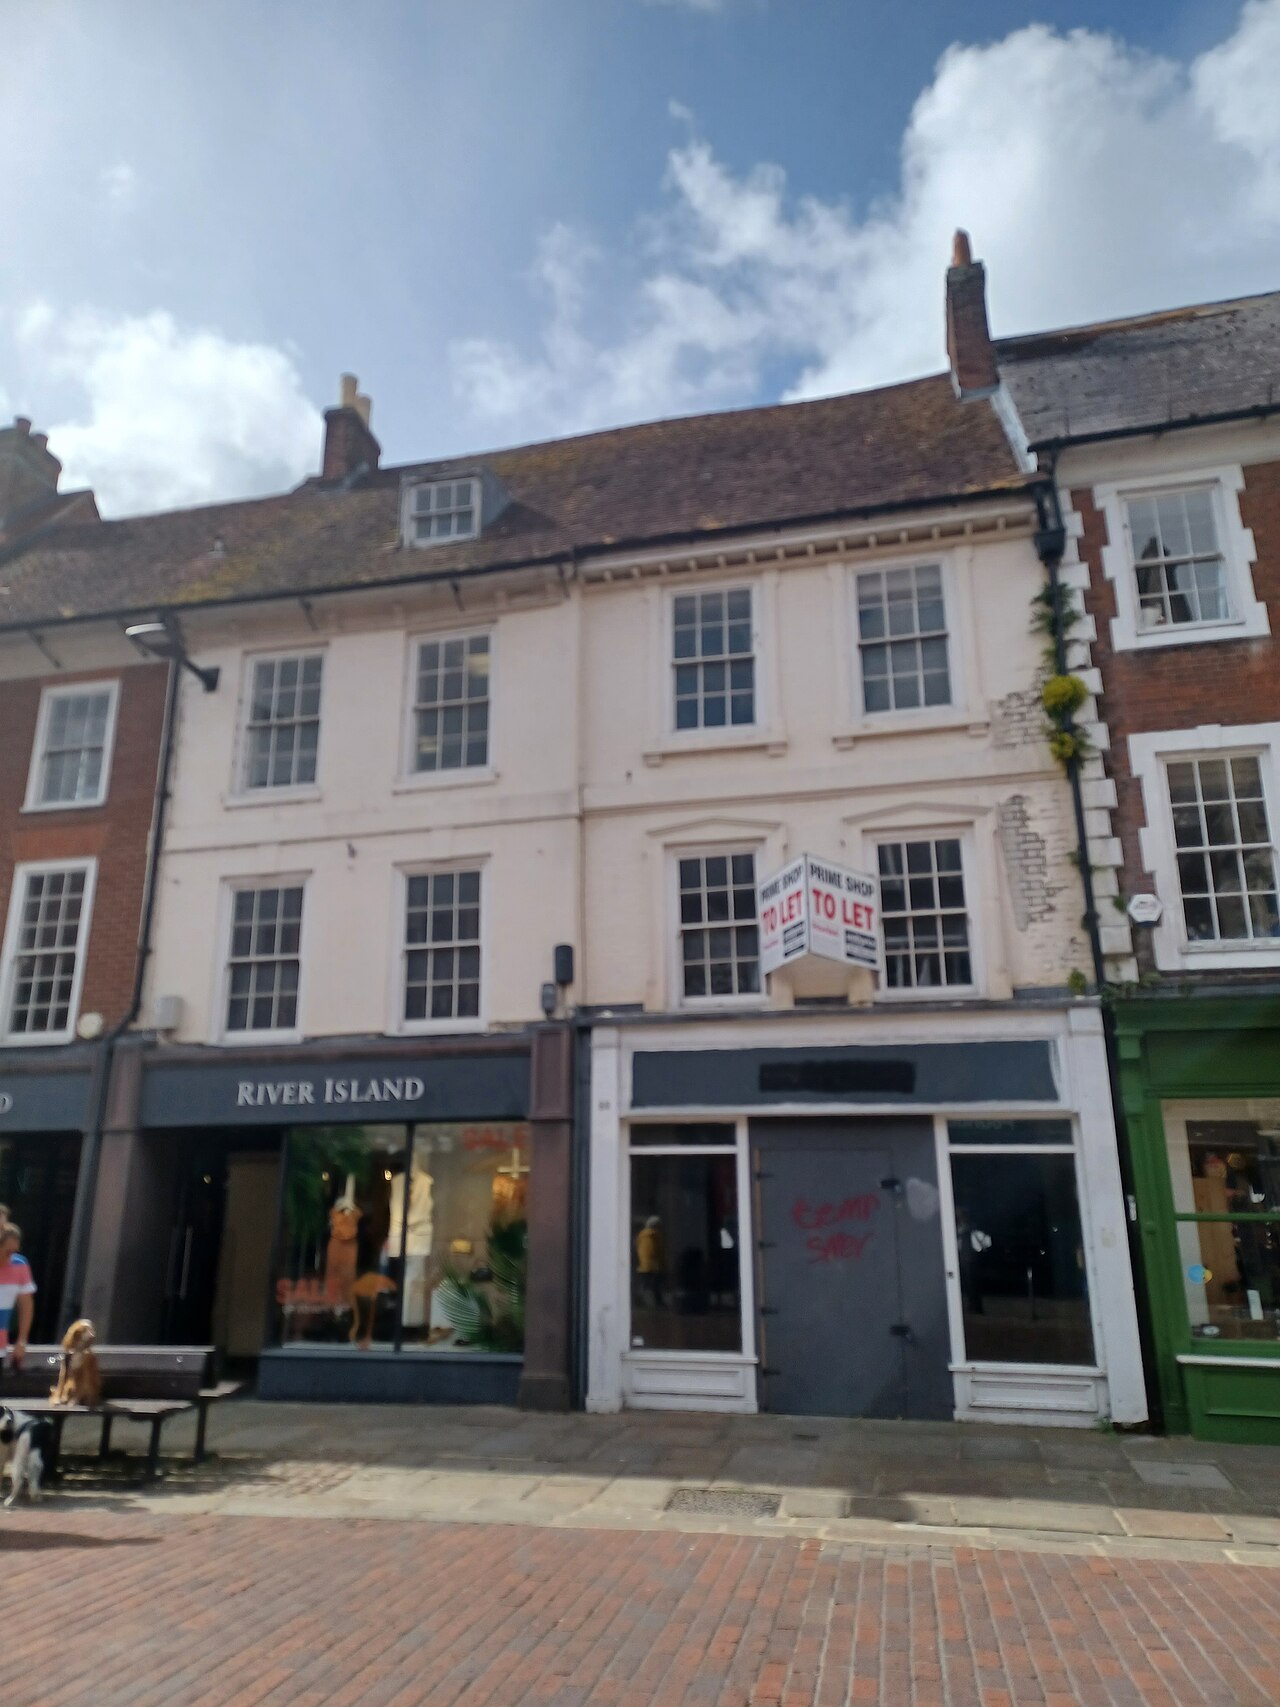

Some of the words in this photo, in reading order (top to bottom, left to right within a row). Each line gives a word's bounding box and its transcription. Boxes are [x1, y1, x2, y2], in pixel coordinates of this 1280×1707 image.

[810, 863, 842, 889] PRIME
[846, 877, 874, 897] SHOP
[762, 906, 778, 935] TO
[781, 889, 802, 925] LET
[812, 887, 836, 920] TO
[842, 897, 874, 931] LET
[237, 1080, 315, 1106] RIVER
[324, 1076, 425, 1104] ISLAND
